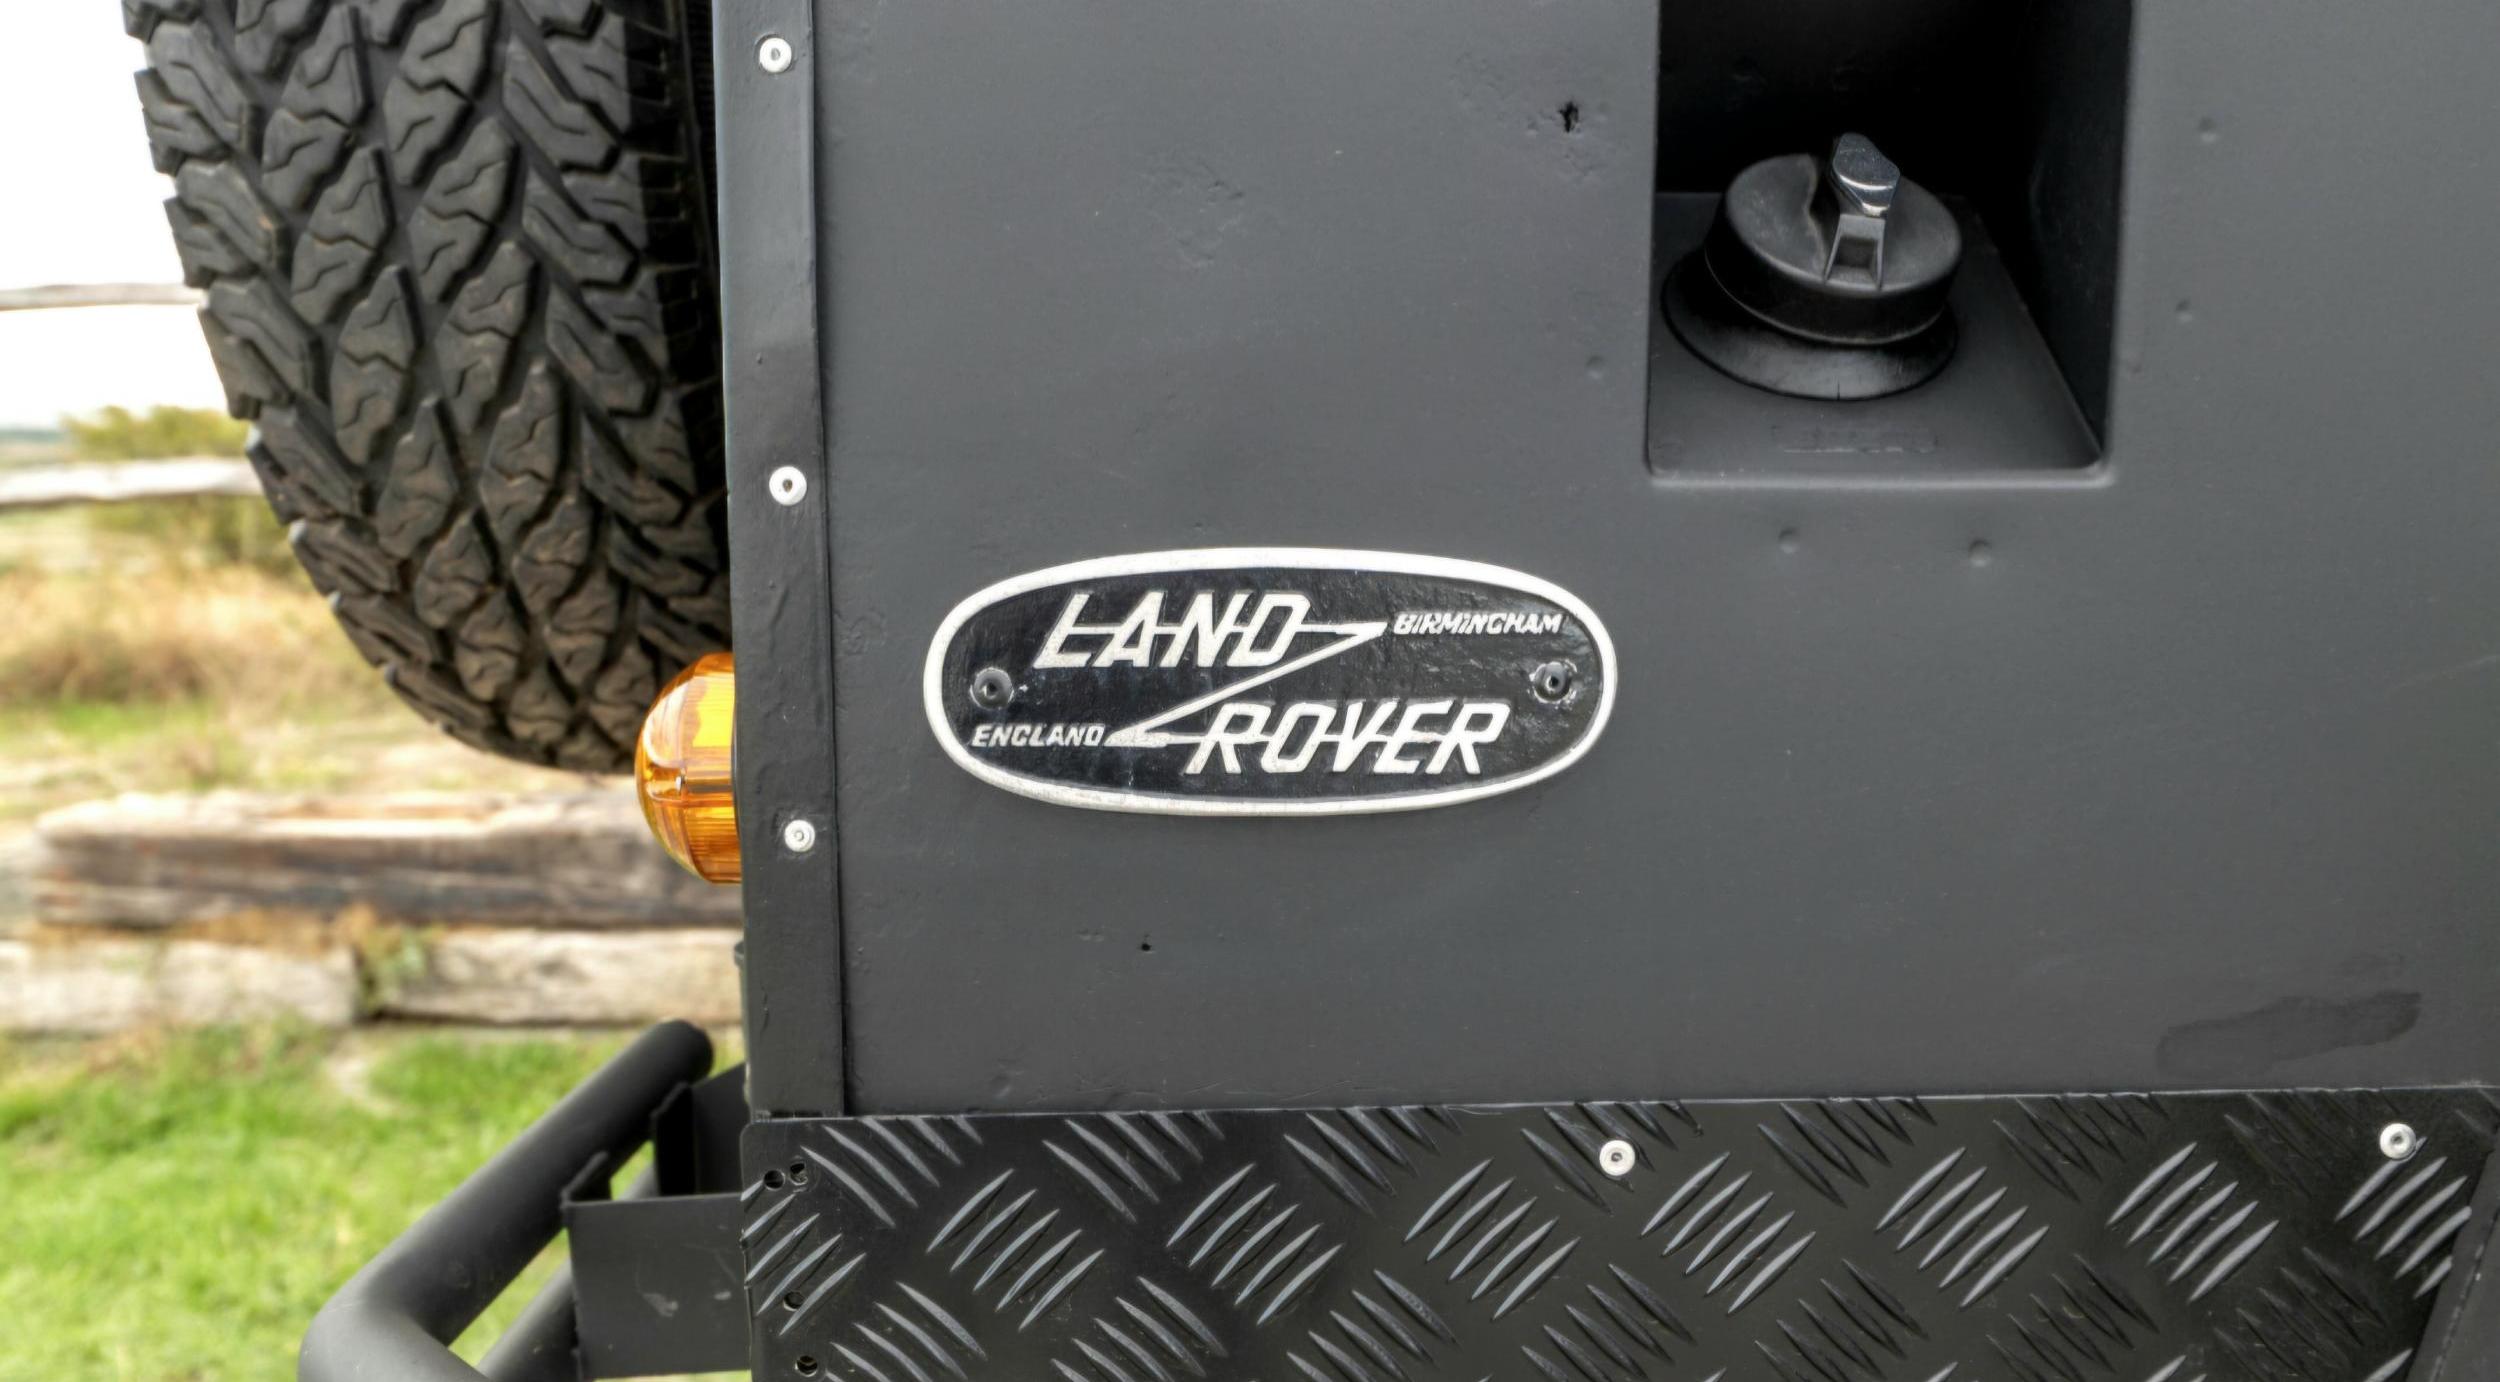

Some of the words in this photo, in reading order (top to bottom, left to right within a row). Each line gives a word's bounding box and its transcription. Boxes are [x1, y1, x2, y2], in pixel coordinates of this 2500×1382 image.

[1034, 591, 1311, 668] LAND
[1393, 612, 1563, 635] BIRMINGHAM
[971, 724, 1106, 747] ENGLAND
[1186, 700, 1511, 774] ROVER
